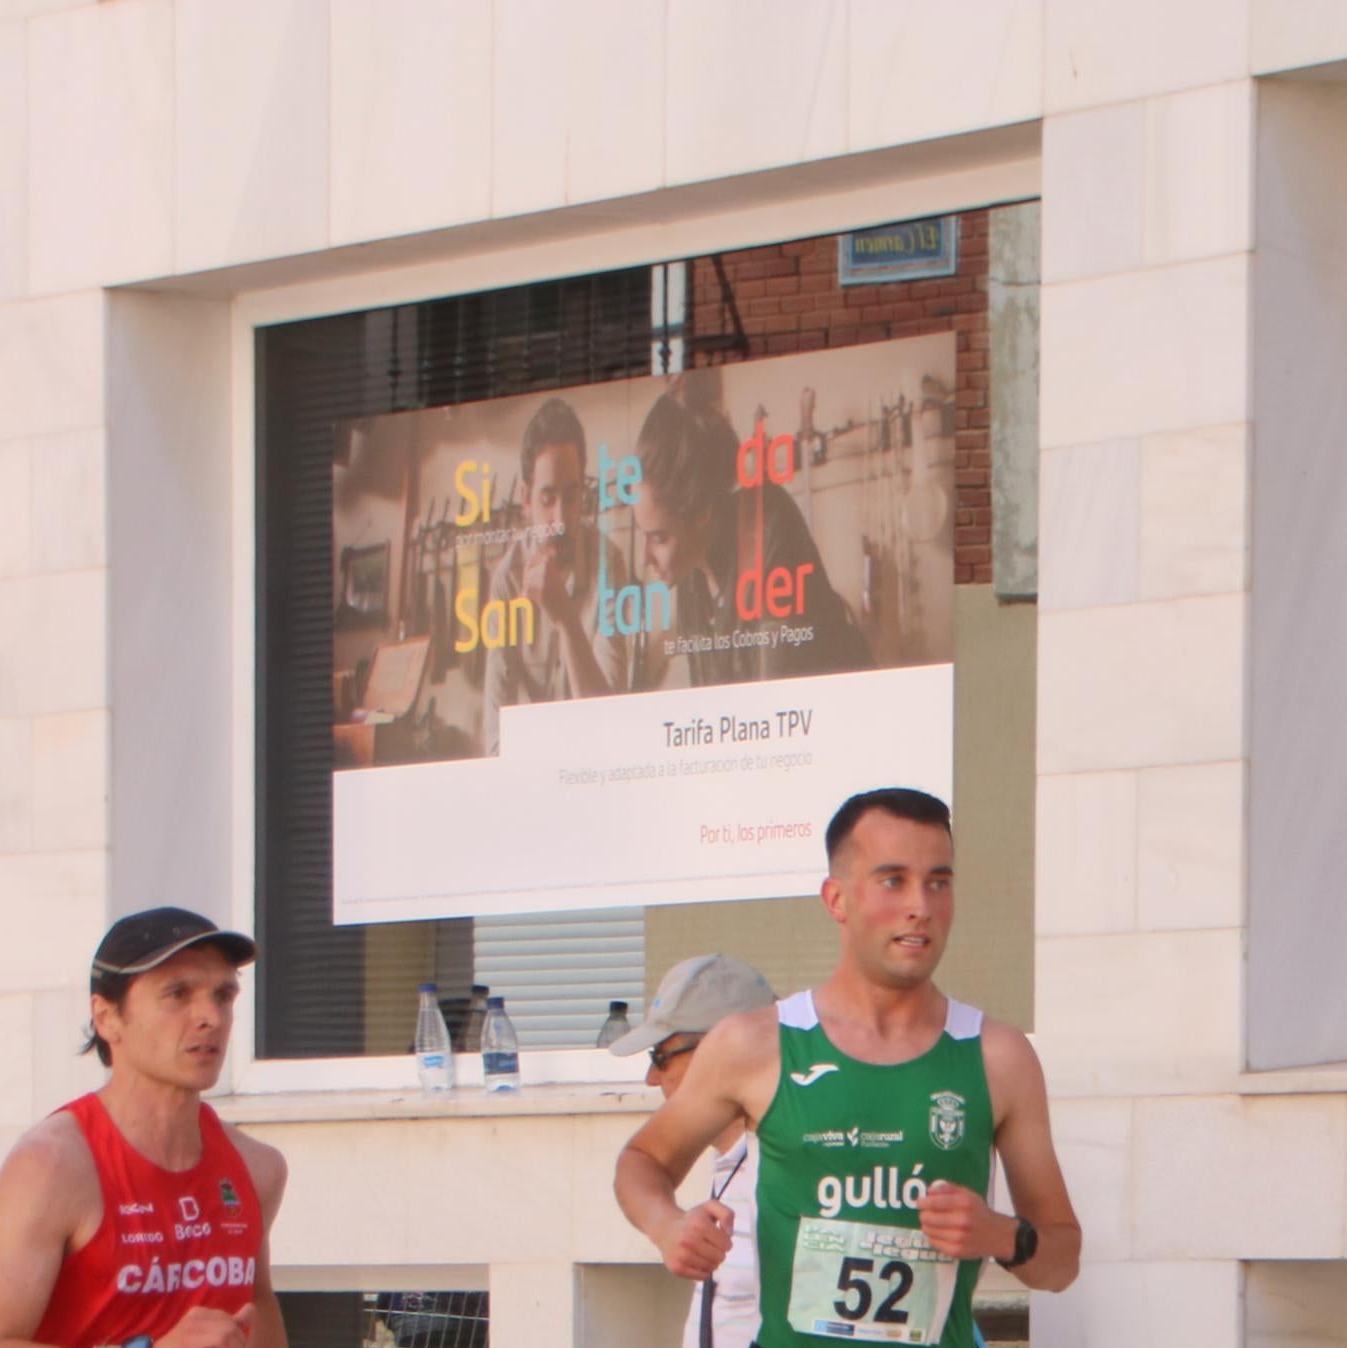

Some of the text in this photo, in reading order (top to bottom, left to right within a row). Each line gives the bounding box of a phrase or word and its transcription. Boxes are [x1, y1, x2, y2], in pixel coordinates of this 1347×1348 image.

[598, 443, 642, 511] te
[736, 416, 795, 489] da
[455, 460, 492, 527] Si
[598, 568, 670, 638] tan
[736, 549, 814, 621] der
[454, 587, 534, 653] San
[664, 624, 814, 655] te facilita los Cobros y Pagos
[663, 709, 812, 748] Tarifa Plana TPV
[701, 819, 812, 845] Por ti, los primeros
[833, 1256, 914, 1325] 52
